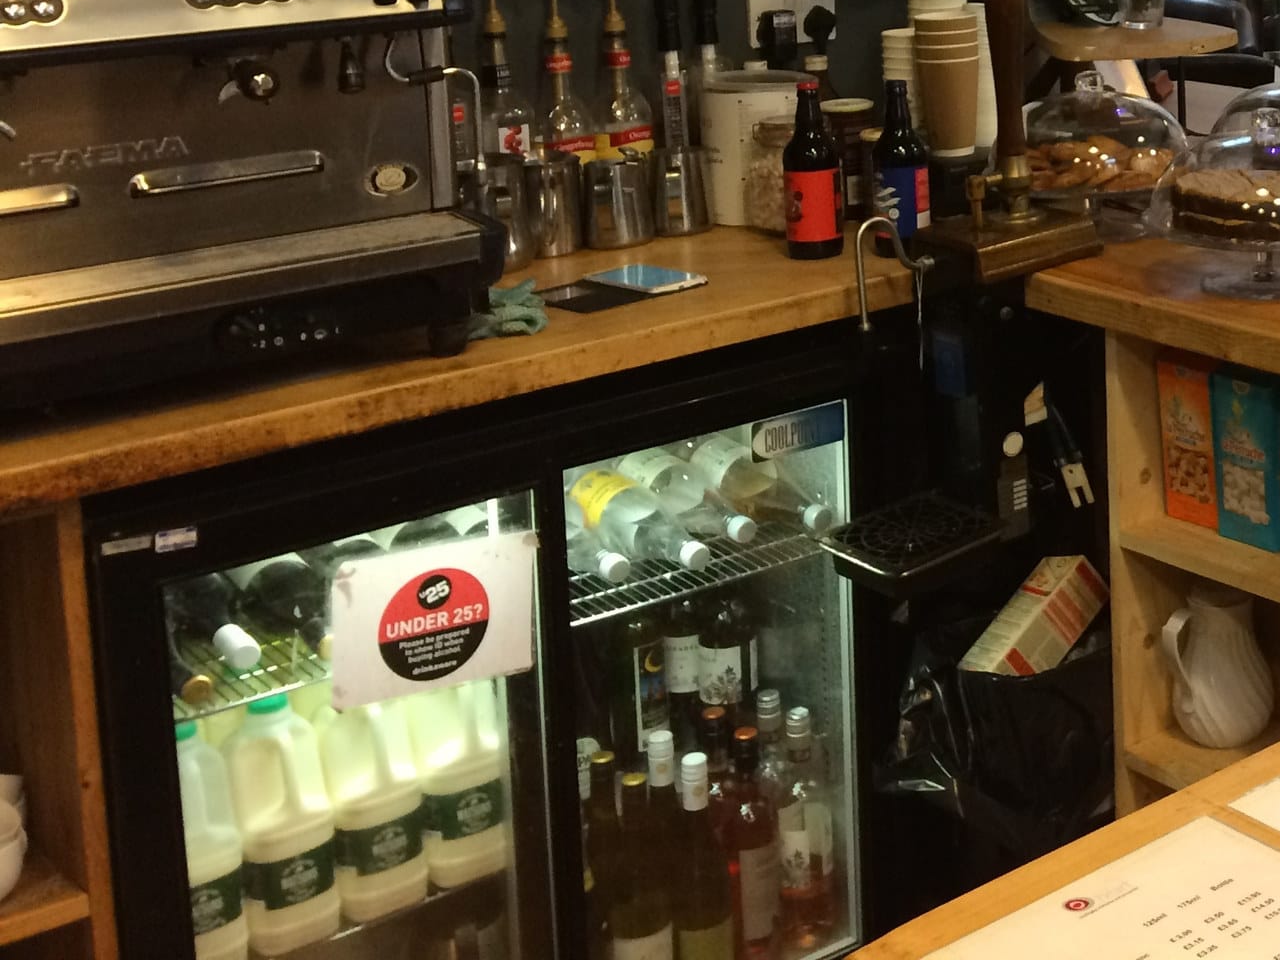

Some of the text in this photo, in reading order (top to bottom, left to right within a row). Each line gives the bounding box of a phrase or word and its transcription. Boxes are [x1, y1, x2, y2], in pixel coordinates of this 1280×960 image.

[386, 603, 483, 639] UNDER 25?
[399, 639, 424, 649] Please
[435, 627, 470, 640] prepared
[414, 646, 433, 654] show
[444, 638, 464, 646] when
[408, 653, 433, 663] buying
[412, 660, 457, 675] drinkaware
[1210, 879, 1234, 891] Bottle
